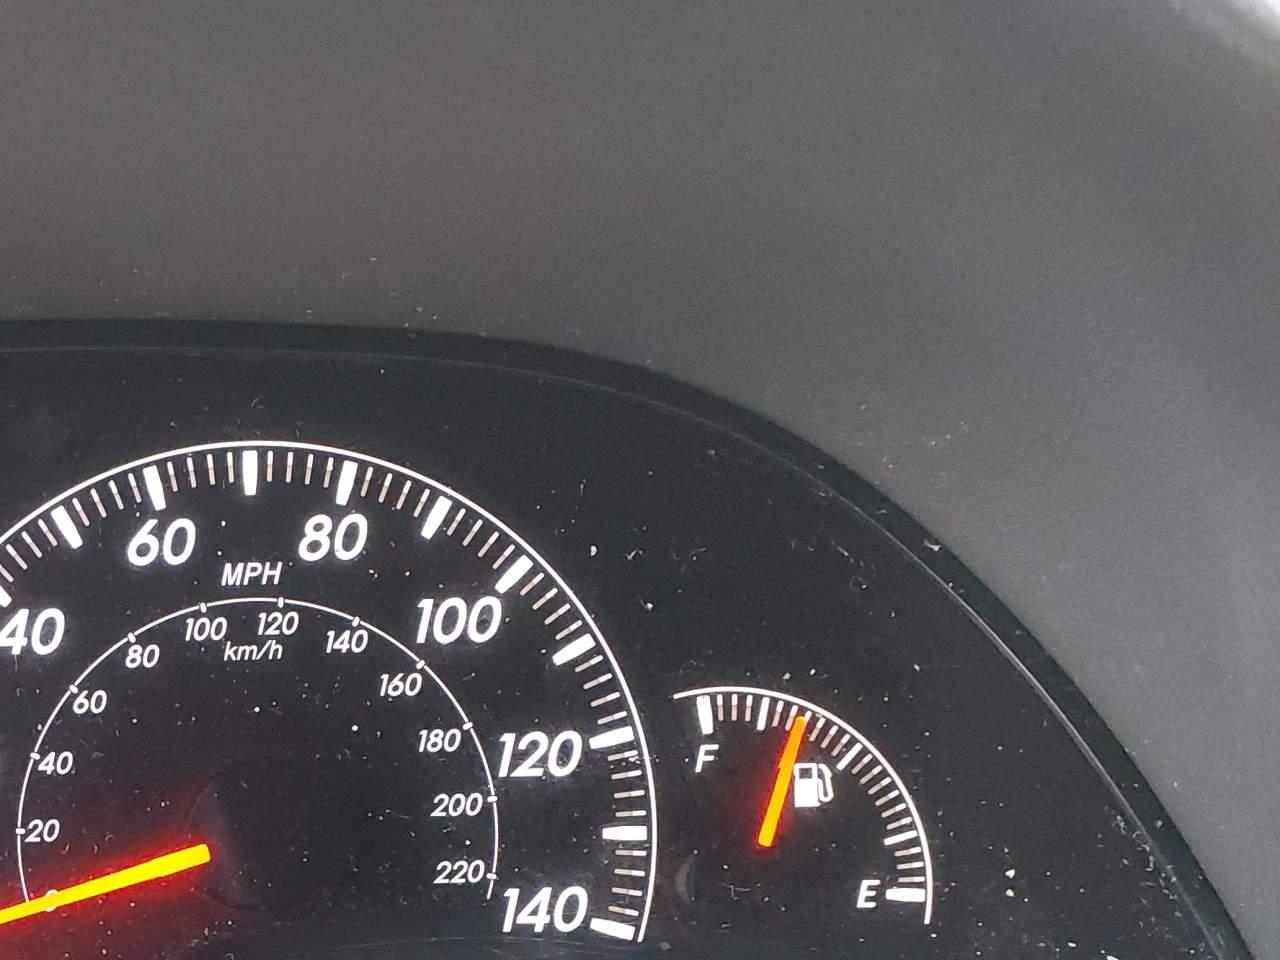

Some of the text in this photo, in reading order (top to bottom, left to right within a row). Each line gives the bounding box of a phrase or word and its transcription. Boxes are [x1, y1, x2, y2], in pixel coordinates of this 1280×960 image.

[127, 518, 196, 566] 60
[298, 513, 368, 561] 80
[220, 562, 282, 588] MPH
[184, 617, 226, 642] 100
[257, 611, 299, 637] 120
[415, 597, 502, 644] 100
[223, 638, 283, 662] km/h
[325, 628, 368, 655] 140
[125, 644, 160, 669] 80
[379, 671, 422, 697] 160
[72, 689, 108, 714] 60
[417, 728, 461, 753] 180
[498, 730, 582, 777] 120
[37, 752, 74, 775] 40
[695, 745, 718, 773] F
[432, 792, 482, 817] 200
[25, 819, 60, 844] 20
[433, 860, 484, 884] 220
[857, 880, 881, 908] E
[502, 886, 587, 934] 140
